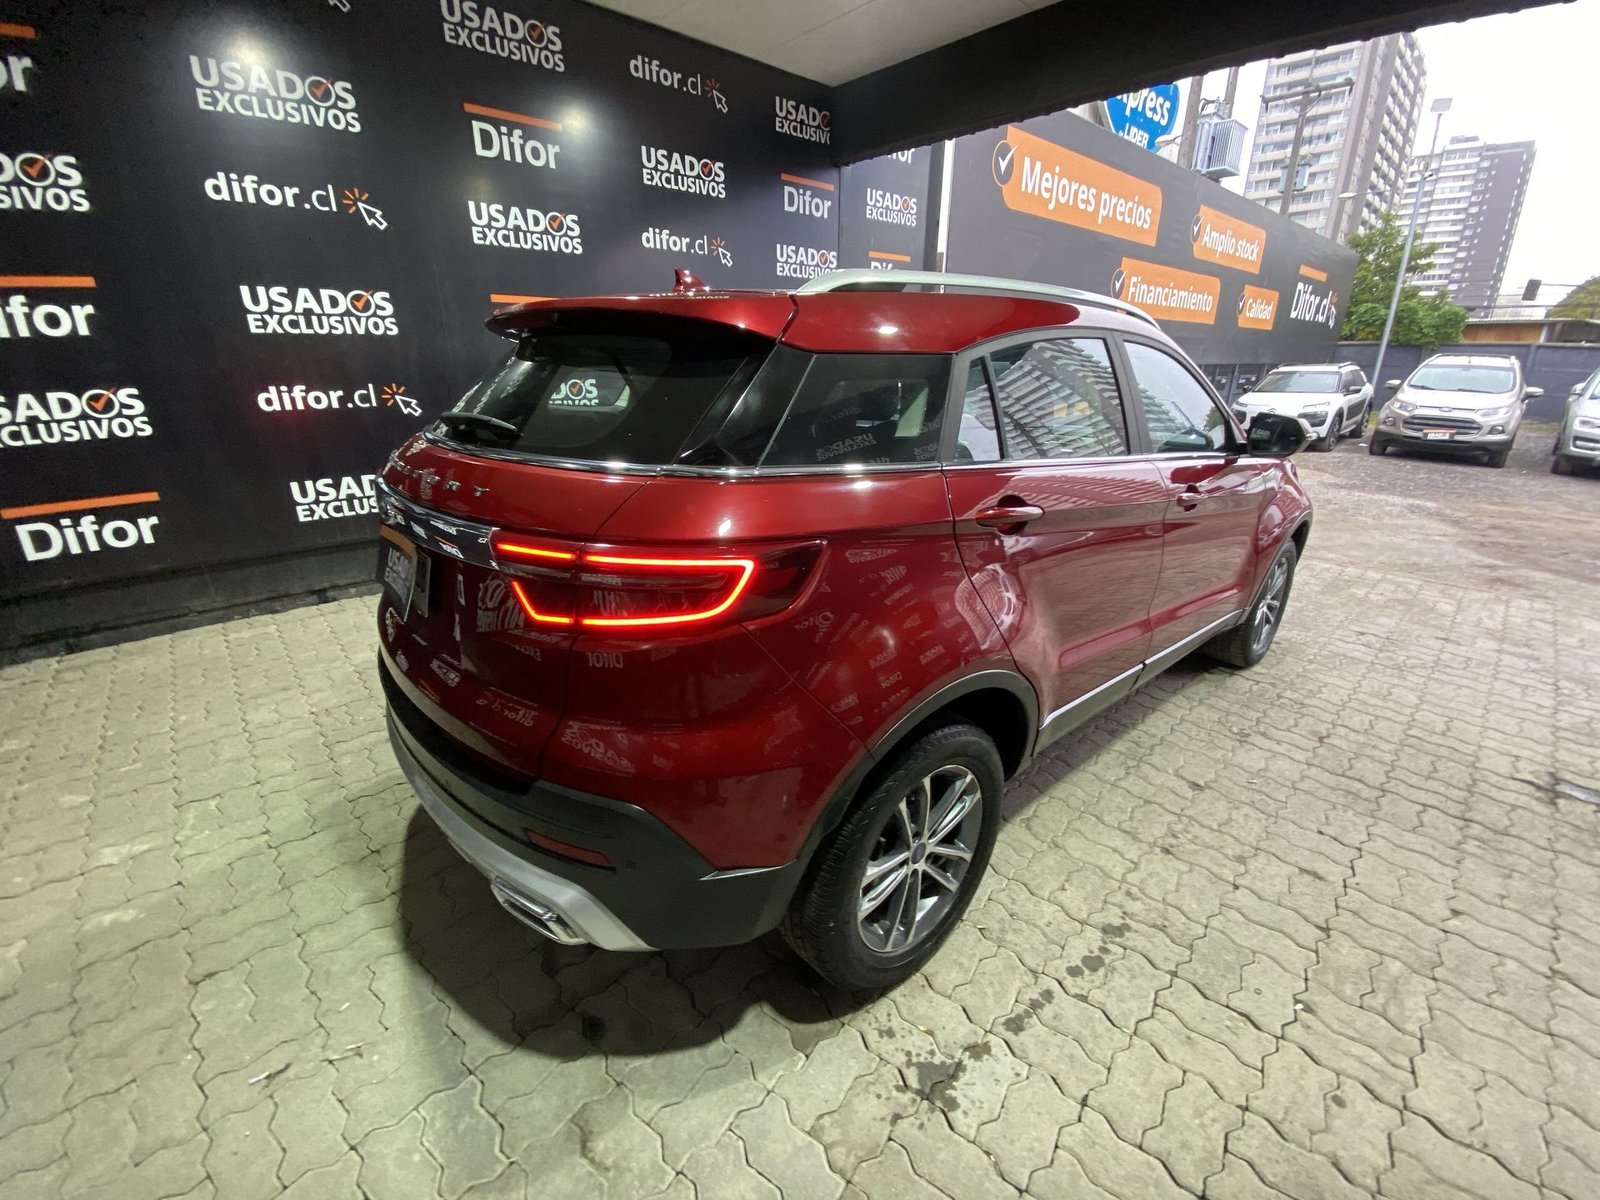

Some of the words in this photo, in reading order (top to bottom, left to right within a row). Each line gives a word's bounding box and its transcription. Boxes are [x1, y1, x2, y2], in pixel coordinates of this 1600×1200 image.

[441, 0, 563, 52] USADOS
[443, 23, 565, 72] EXCLUSIVOS
[189, 55, 357, 110] USADOS
[629, 55, 701, 96] difor.cl
[195, 88, 361, 133] EXCLUSIVOS
[471, 119, 560, 169] Difor
[1124, 122, 1149, 149] LIDER
[641, 145, 725, 183] USADOS
[204, 172, 337, 212] difor.cl
[642, 168, 726, 198] EXCLUSIVOS
[866, 188, 917, 214] USADOS
[1021, 156, 1096, 212] Mejores
[1097, 190, 1152, 230] precios
[468, 201, 581, 237] USADOS
[784, 185, 832, 219] Difor
[866, 206, 917, 227] EXCLUSIVOS
[472, 225, 583, 254] EXCLUSIVOS
[641, 228, 707, 255] difor.cl
[776, 243, 837, 269] USADOS
[1201, 222, 1237, 258] Amplio
[1235, 236, 1259, 262] stock
[239, 285, 394, 317] USADOS
[1128, 276, 1212, 313] Financiamiento
[1245, 297, 1272, 320] Calidad
[1290, 282, 1331, 322] Difor.cl
[246, 314, 399, 335] EXCLUSIVOS
[257, 384, 377, 412] difor.cl
[0, 416, 153, 448] CLUSIVOS
[15, 513, 161, 562] Difor
